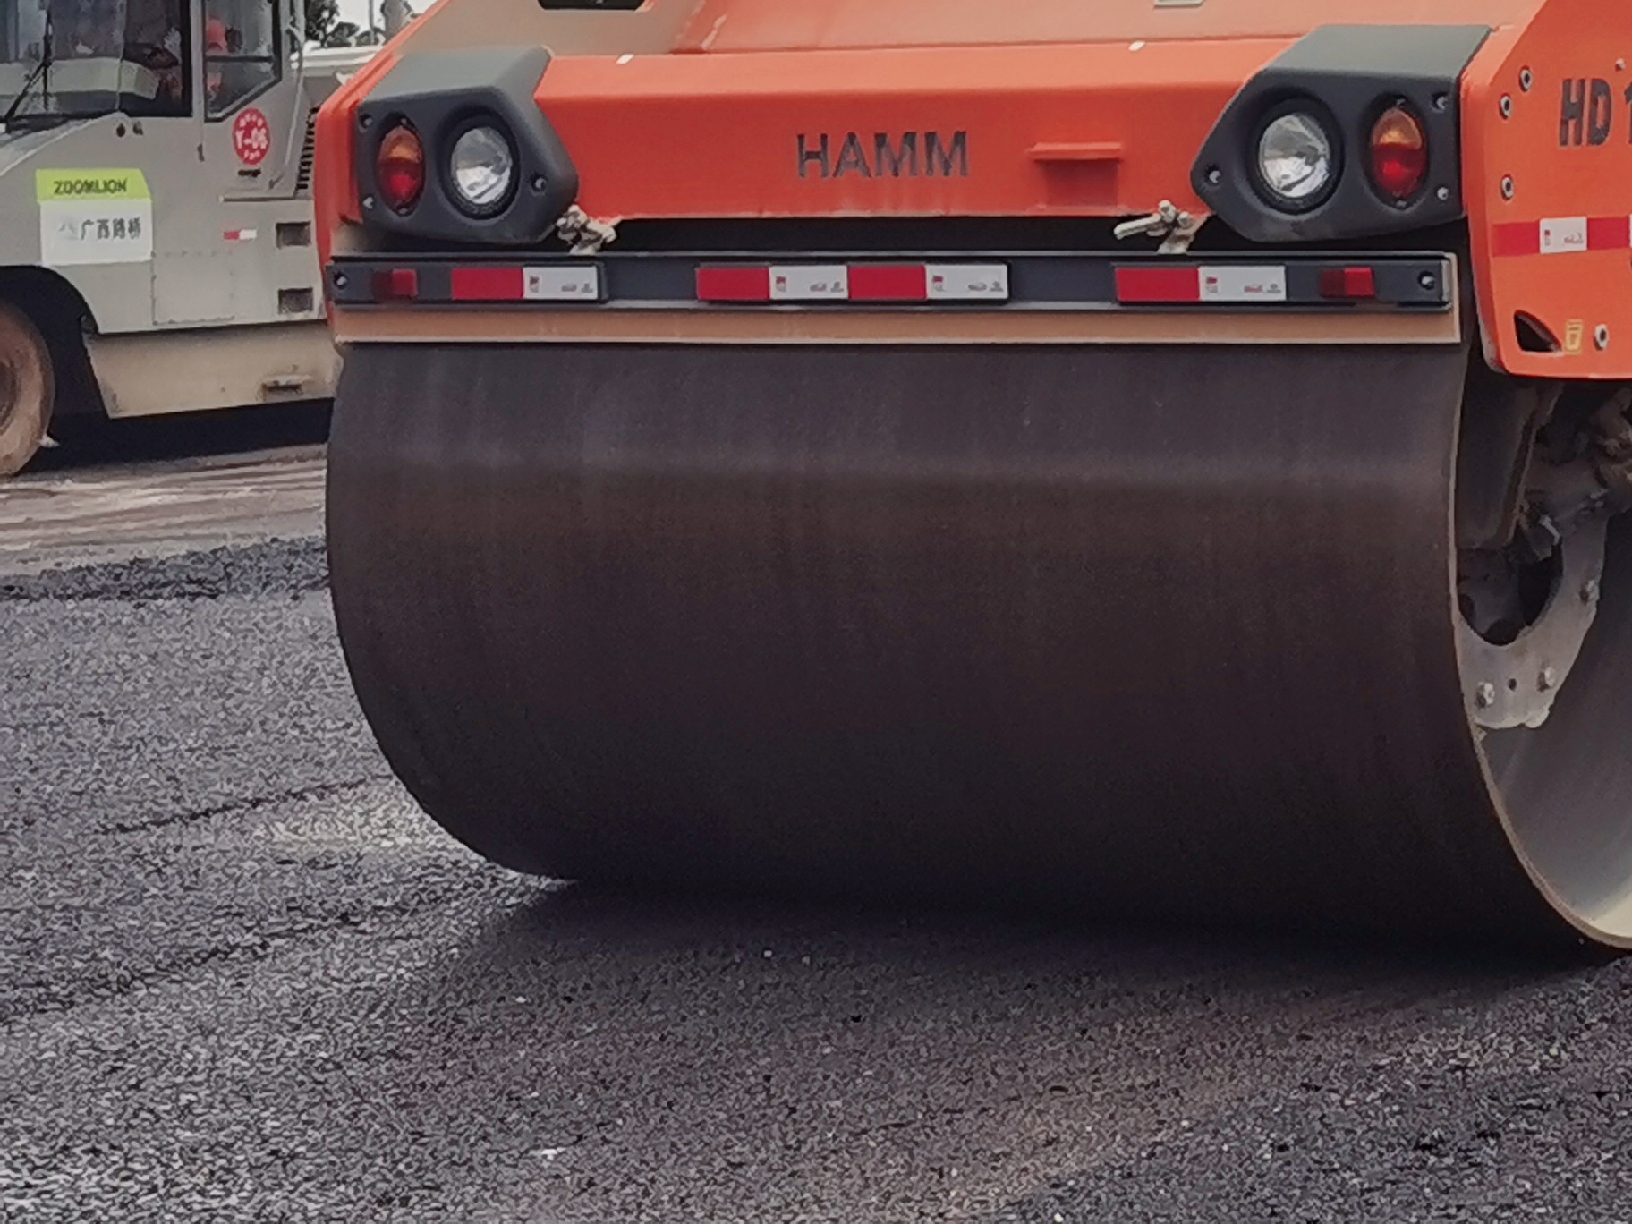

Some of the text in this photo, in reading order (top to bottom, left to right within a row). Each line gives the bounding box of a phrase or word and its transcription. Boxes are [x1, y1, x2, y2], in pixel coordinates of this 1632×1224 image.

[1559, 78, 1611, 146] HD
[797, 131, 967, 178] HAMM
[54, 178, 127, 195] ZOOMLION
